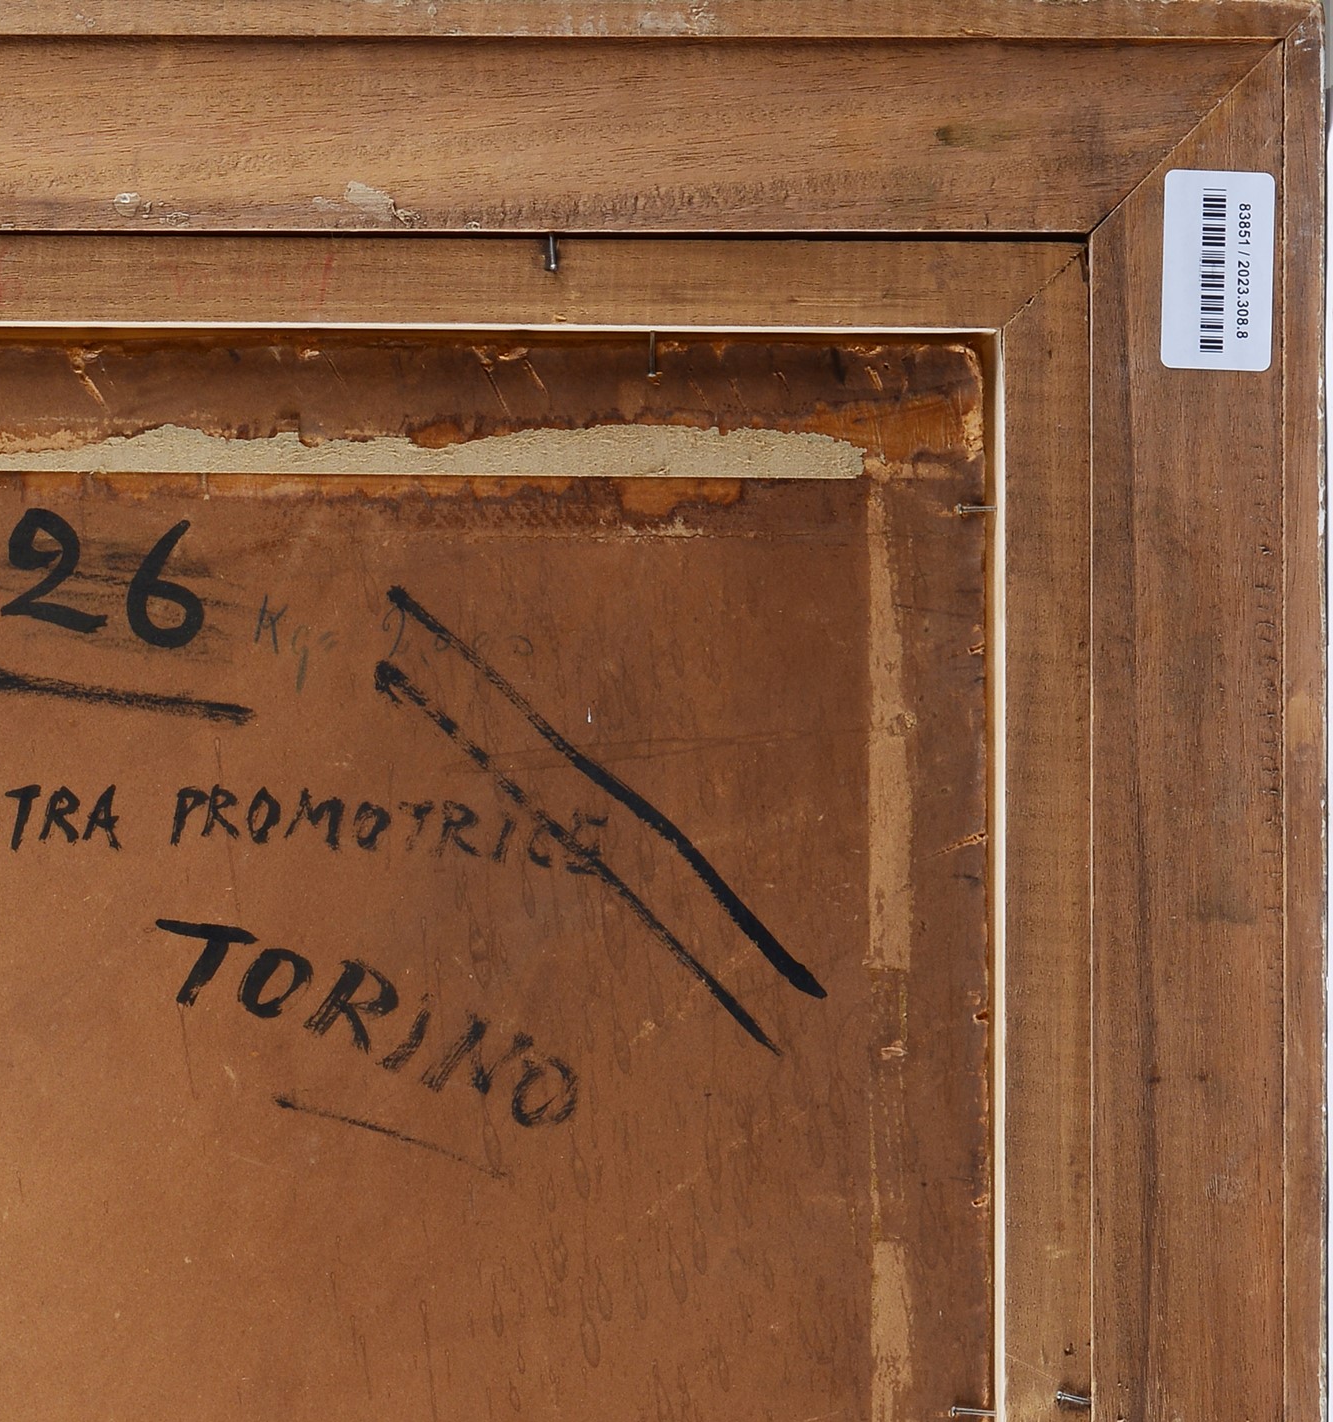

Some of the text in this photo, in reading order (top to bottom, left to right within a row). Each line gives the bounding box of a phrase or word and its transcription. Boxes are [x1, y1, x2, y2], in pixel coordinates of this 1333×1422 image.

[1238, 203, 1251, 245] 83851
[1236, 260, 1250, 339] 2023.308.8
[0, 507, 206, 649] 26
[171, 784, 609, 876] PROMOTRICE
[154, 917, 579, 1128] TORINO
